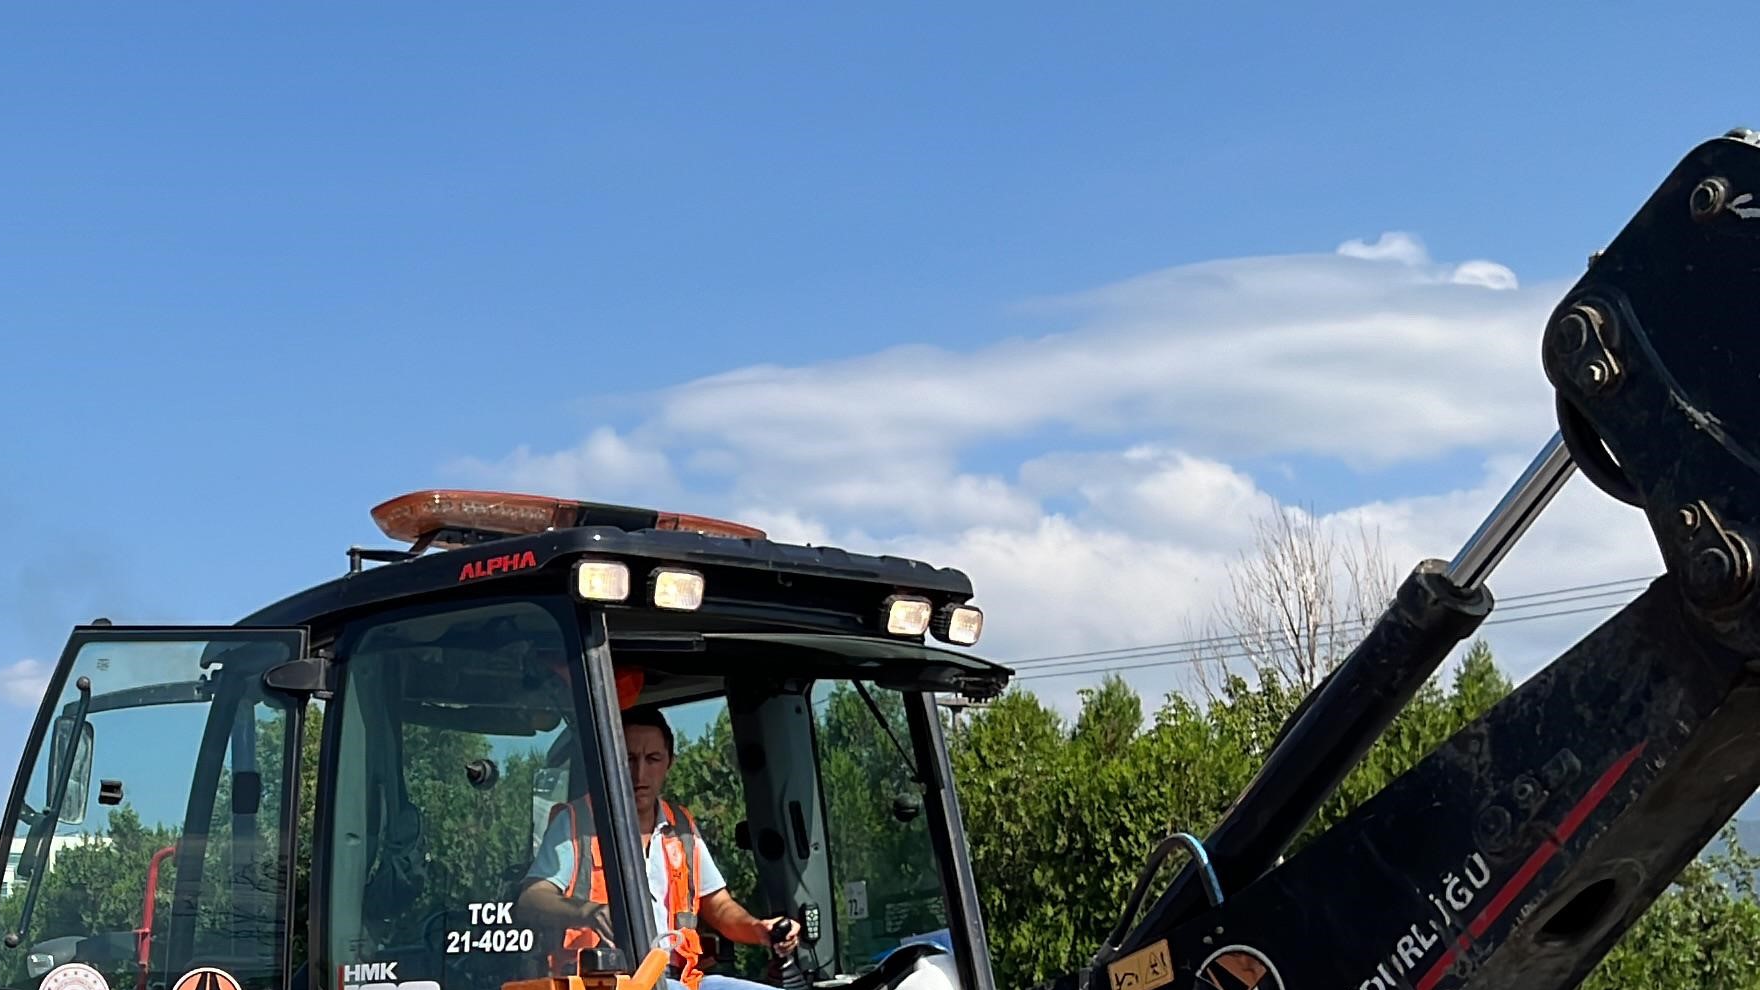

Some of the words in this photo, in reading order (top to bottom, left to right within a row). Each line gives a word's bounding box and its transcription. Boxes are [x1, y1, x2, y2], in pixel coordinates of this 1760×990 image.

[459, 551, 537, 582] ALPHA
[468, 902, 514, 925] TCK
[446, 929, 534, 953] 21-4020
[344, 962, 398, 982] HMK
